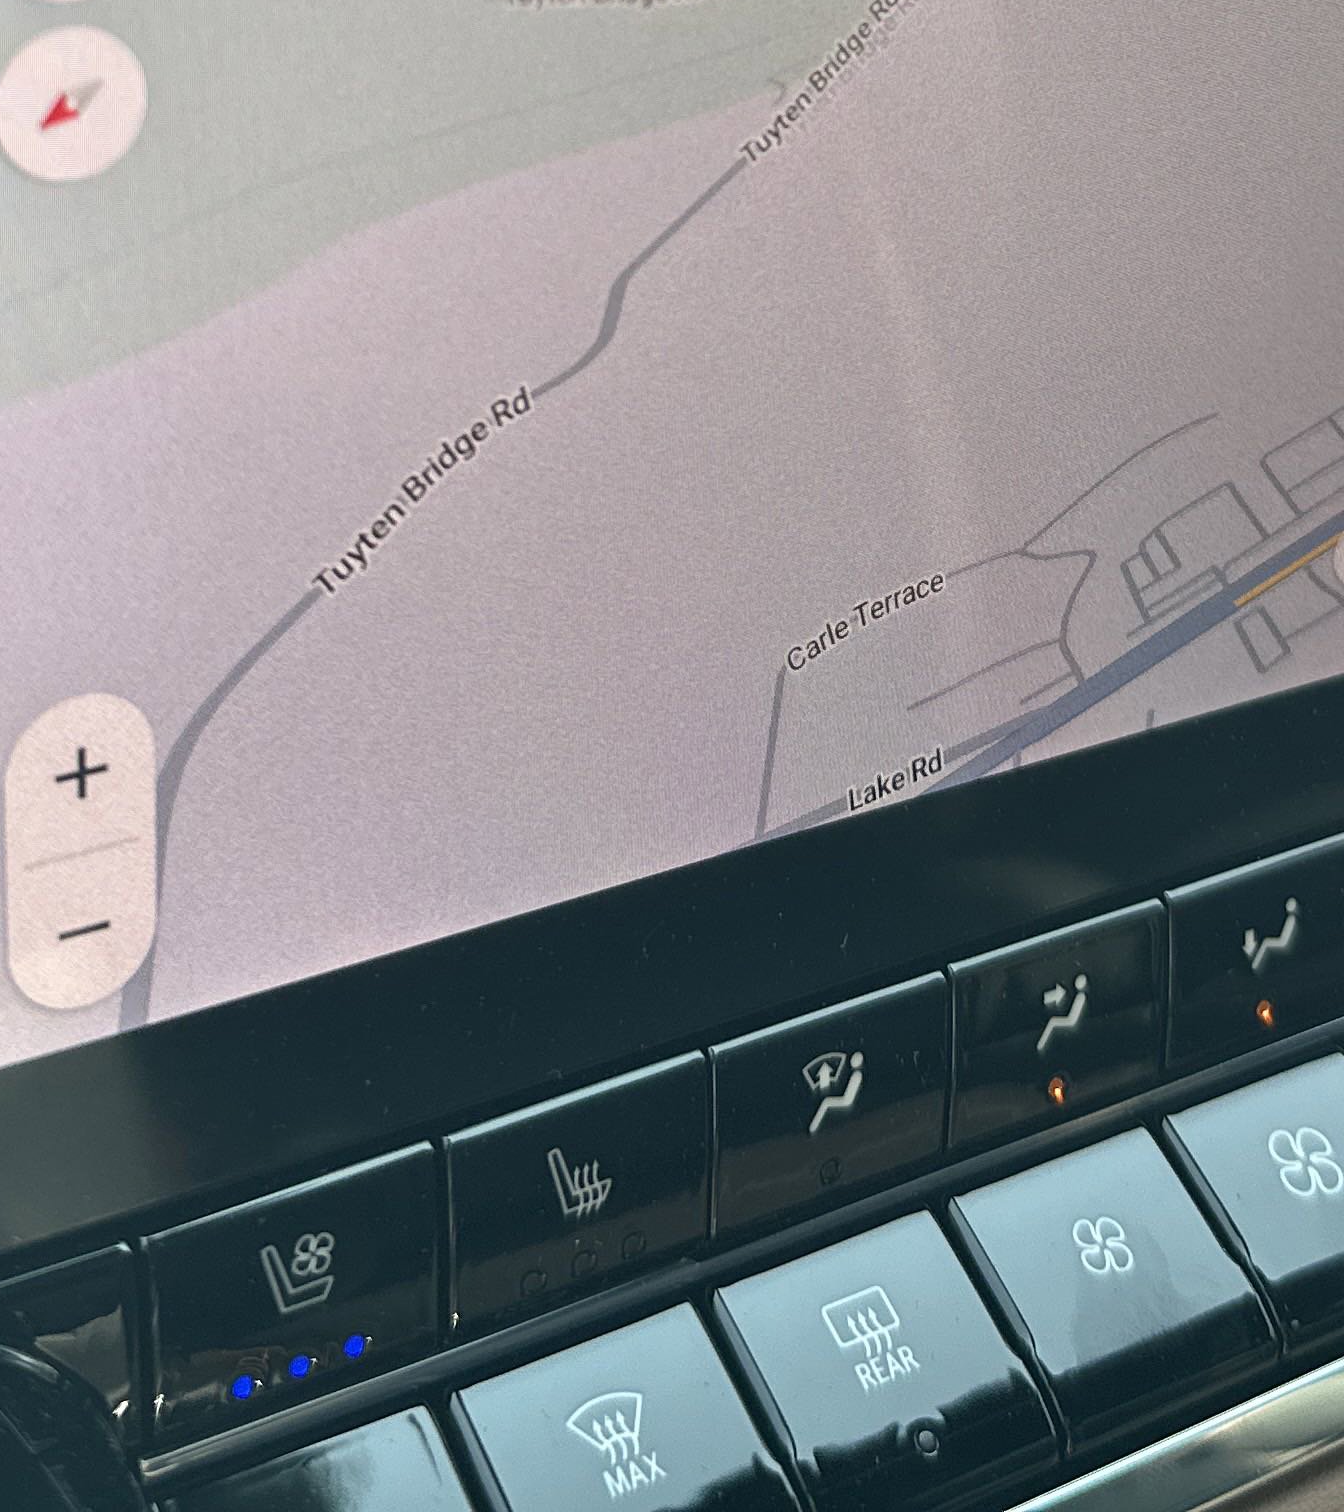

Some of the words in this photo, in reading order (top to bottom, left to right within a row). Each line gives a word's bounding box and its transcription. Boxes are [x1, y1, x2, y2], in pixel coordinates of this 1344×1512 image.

[740, 88, 813, 165] Tuyten
[808, 22, 872, 94] Bridge
[311, 502, 406, 593] Tuyten
[401, 420, 490, 502] Bridge
[490, 386, 532, 427] Rd
[786, 620, 849, 671] Carle
[852, 573, 944, 627] Terrace
[847, 770, 905, 812] Lake
[911, 748, 944, 783] Rd
[853, 1344, 921, 1392] REAR
[602, 1451, 668, 1499] MAX
